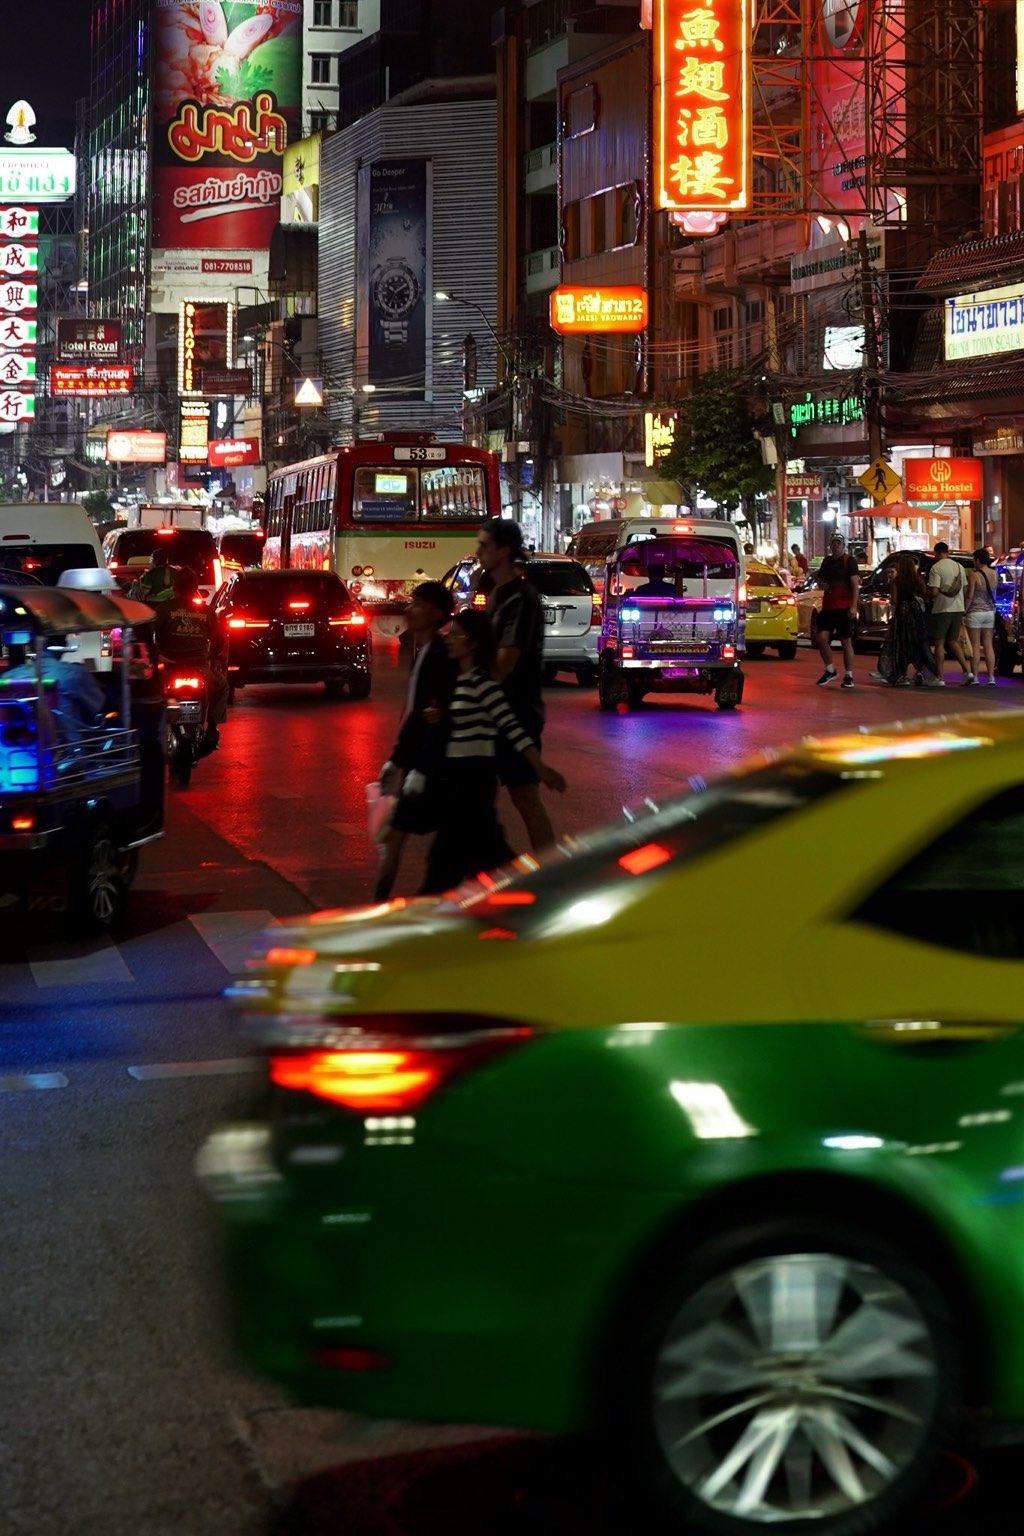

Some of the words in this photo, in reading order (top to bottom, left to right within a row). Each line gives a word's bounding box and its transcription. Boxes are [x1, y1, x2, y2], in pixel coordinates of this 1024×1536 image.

[168, 94, 287, 162] มาม่า
[174, 171, 282, 207] รสต้มยำกุ้ง
[1, 211, 28, 417] 和成興大金行
[61, 341, 86, 350] Hotel
[89, 341, 118, 351] Royal
[972, 337, 993, 354] TOWN
[995, 332, 1021, 350] SCALA
[410, 447, 428, 460] 53
[908, 483, 938, 492] Scala
[940, 482, 973, 492] Hostel
[405, 541, 436, 549] ISUZU
